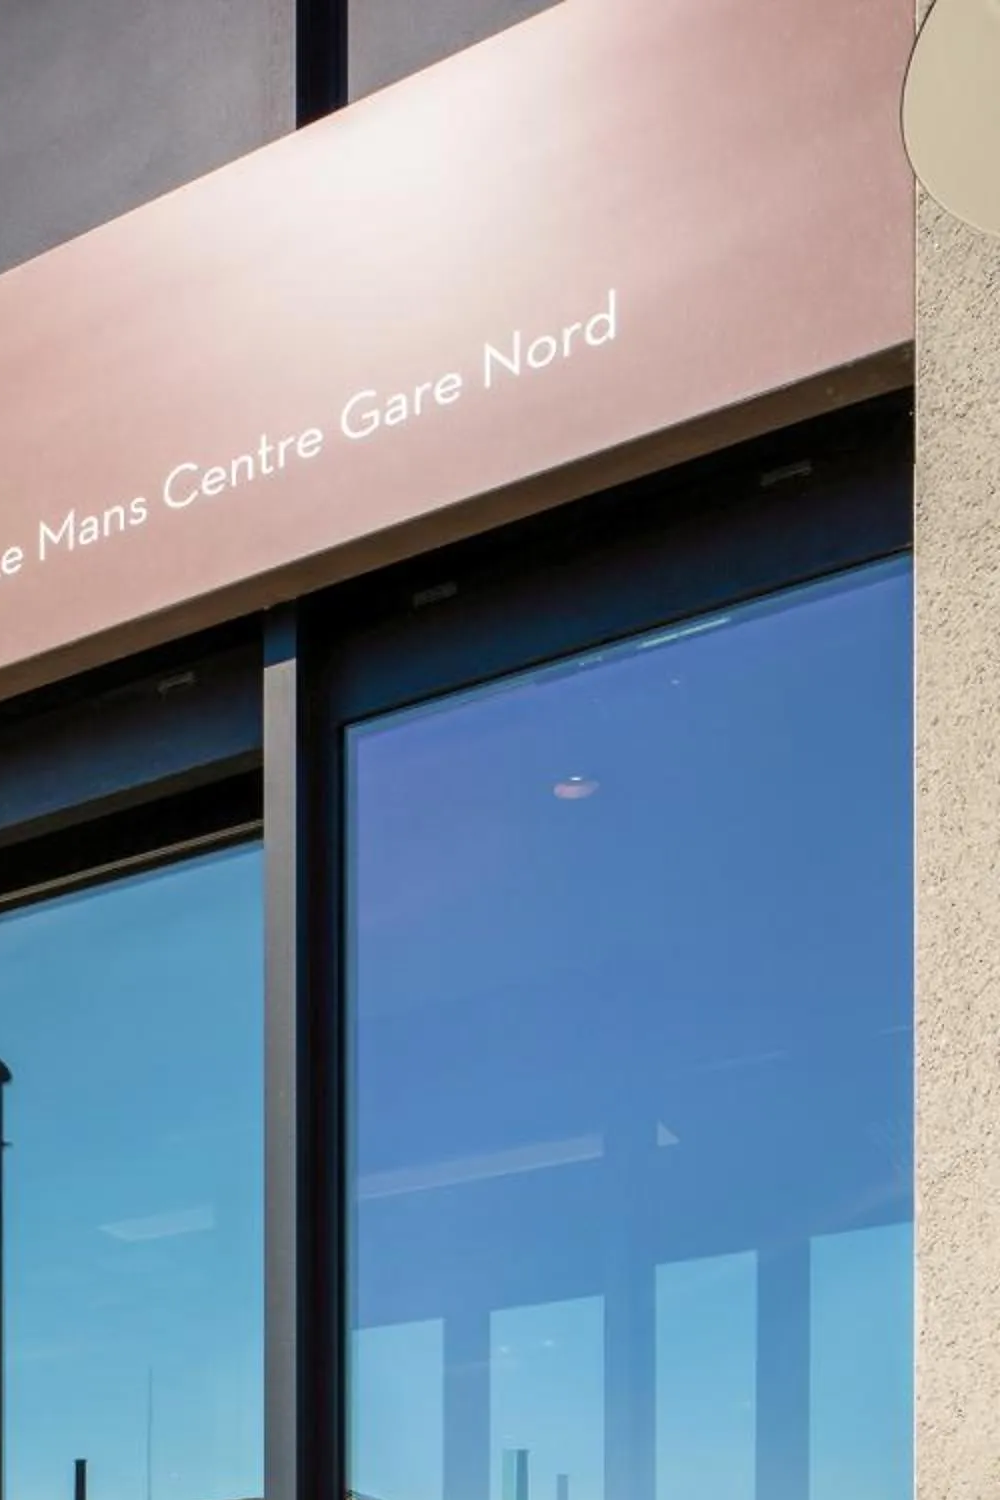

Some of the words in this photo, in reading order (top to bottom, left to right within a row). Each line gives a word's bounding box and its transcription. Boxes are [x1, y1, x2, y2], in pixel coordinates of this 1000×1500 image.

[38, 496, 148, 561] Mans
[162, 426, 323, 509] Centre
[340, 371, 463, 439] Gare
[483, 289, 618, 389] Nord
